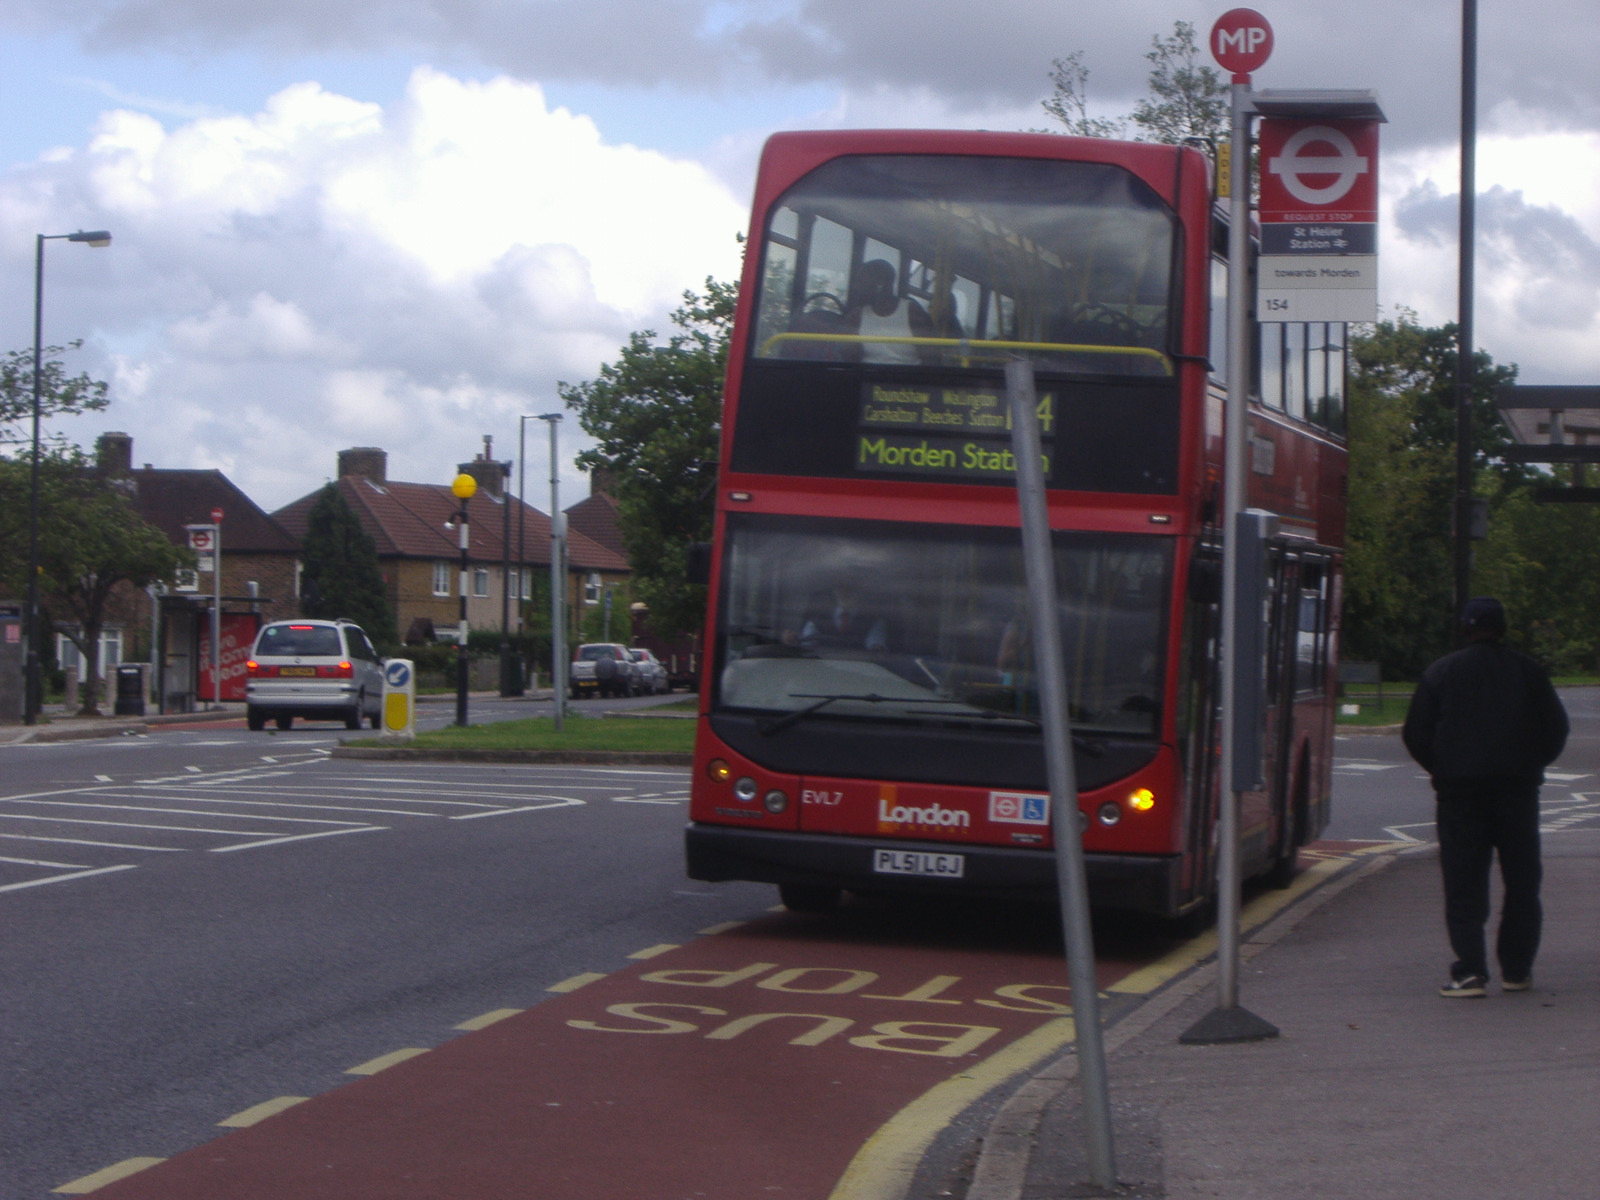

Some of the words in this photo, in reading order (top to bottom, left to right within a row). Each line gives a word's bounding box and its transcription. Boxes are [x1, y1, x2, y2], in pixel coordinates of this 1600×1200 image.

[1218, 27, 1267, 55] MP
[1283, 212, 1327, 222] REQUEST
[1329, 213, 1355, 222] STOP
[1294, 227, 1306, 237] St
[1309, 226, 1344, 237] Helier
[1289, 238, 1331, 249] Station
[1274, 268, 1318, 278] towards
[1320, 268, 1361, 278] Morden
[1266, 299, 1289, 311] 154
[1005, 393, 1055, 432] 14
[859, 437, 957, 468] Morden
[962, 442, 1050, 474] Statin
[801, 789, 843, 806] EVL7
[879, 799, 971, 828] London
[924, 855, 961, 875] LGJ
[639, 962, 1110, 1015] STOP
[565, 1002, 1001, 1058] BUS
